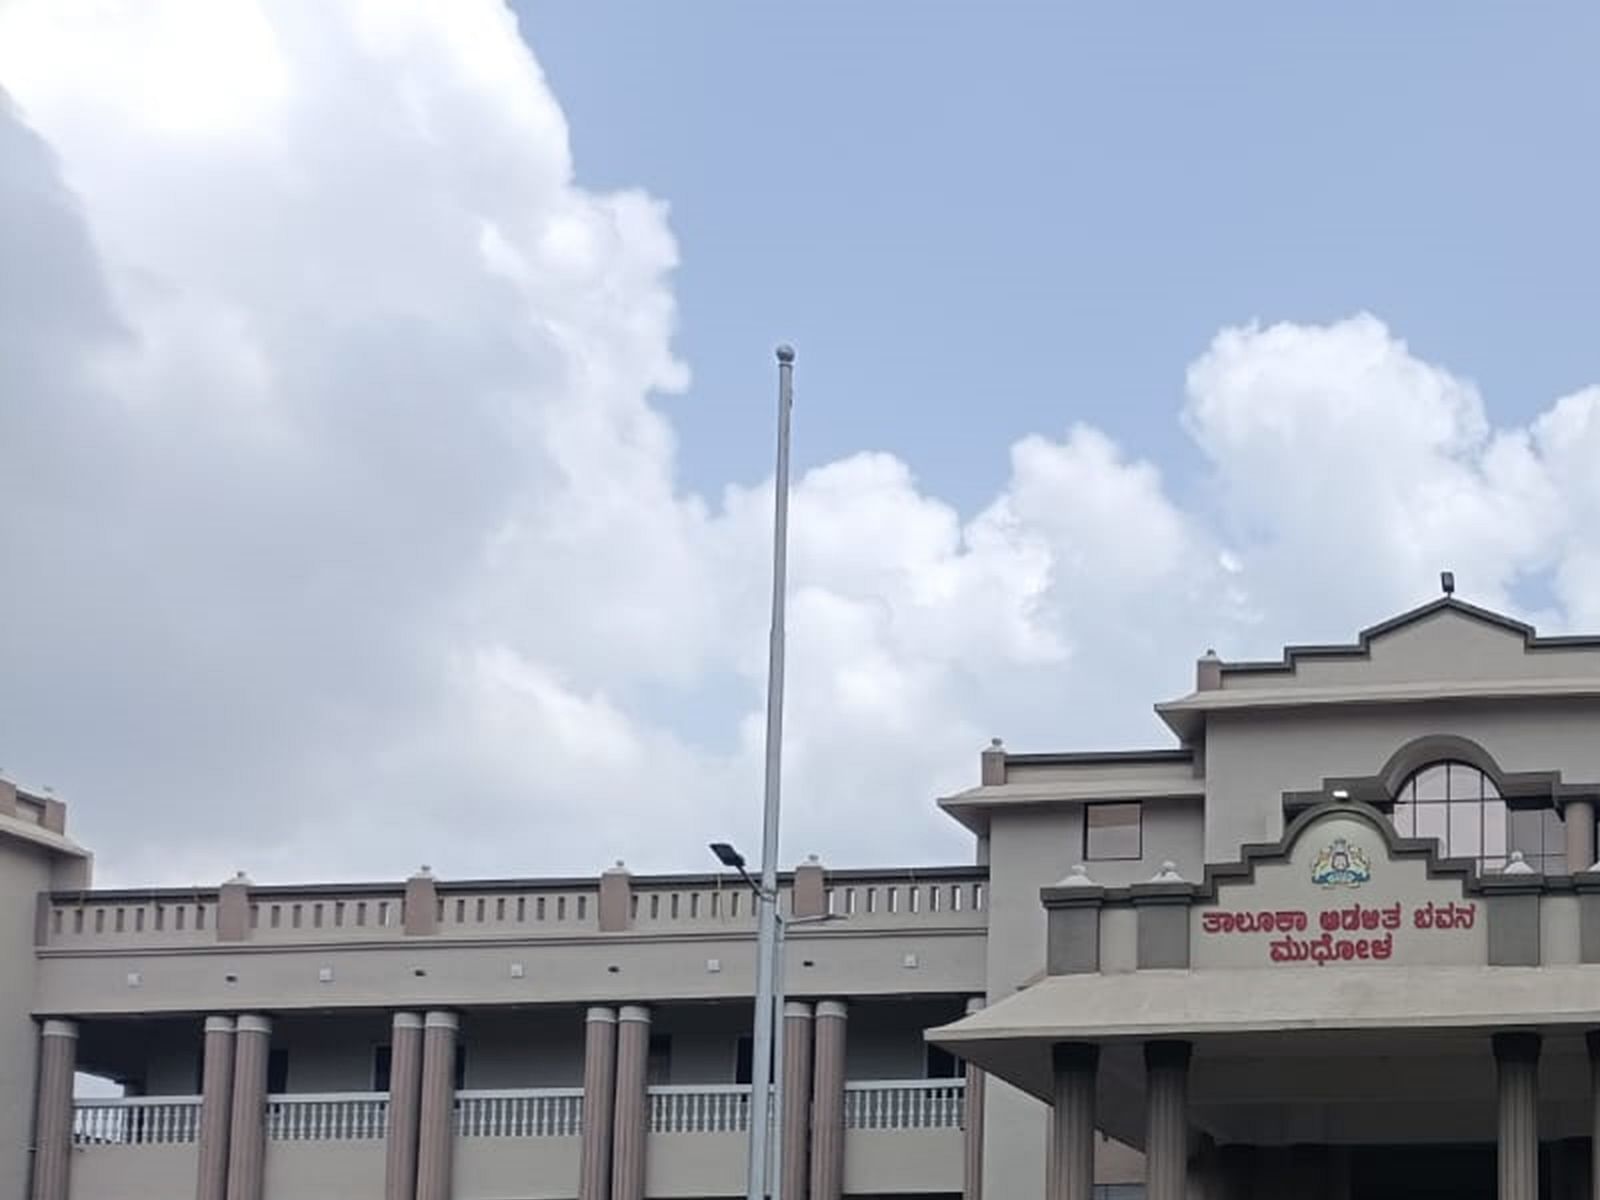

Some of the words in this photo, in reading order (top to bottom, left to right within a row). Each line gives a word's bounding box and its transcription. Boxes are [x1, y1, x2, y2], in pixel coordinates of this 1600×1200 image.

[1202, 911, 1308, 934] ತಾಲೂಕಾ
[1319, 903, 1403, 932] ಆಡಳಿತ
[1413, 901, 1476, 930] ಭವನ
[1270, 933, 1394, 966] ಮುಧೋಳ
